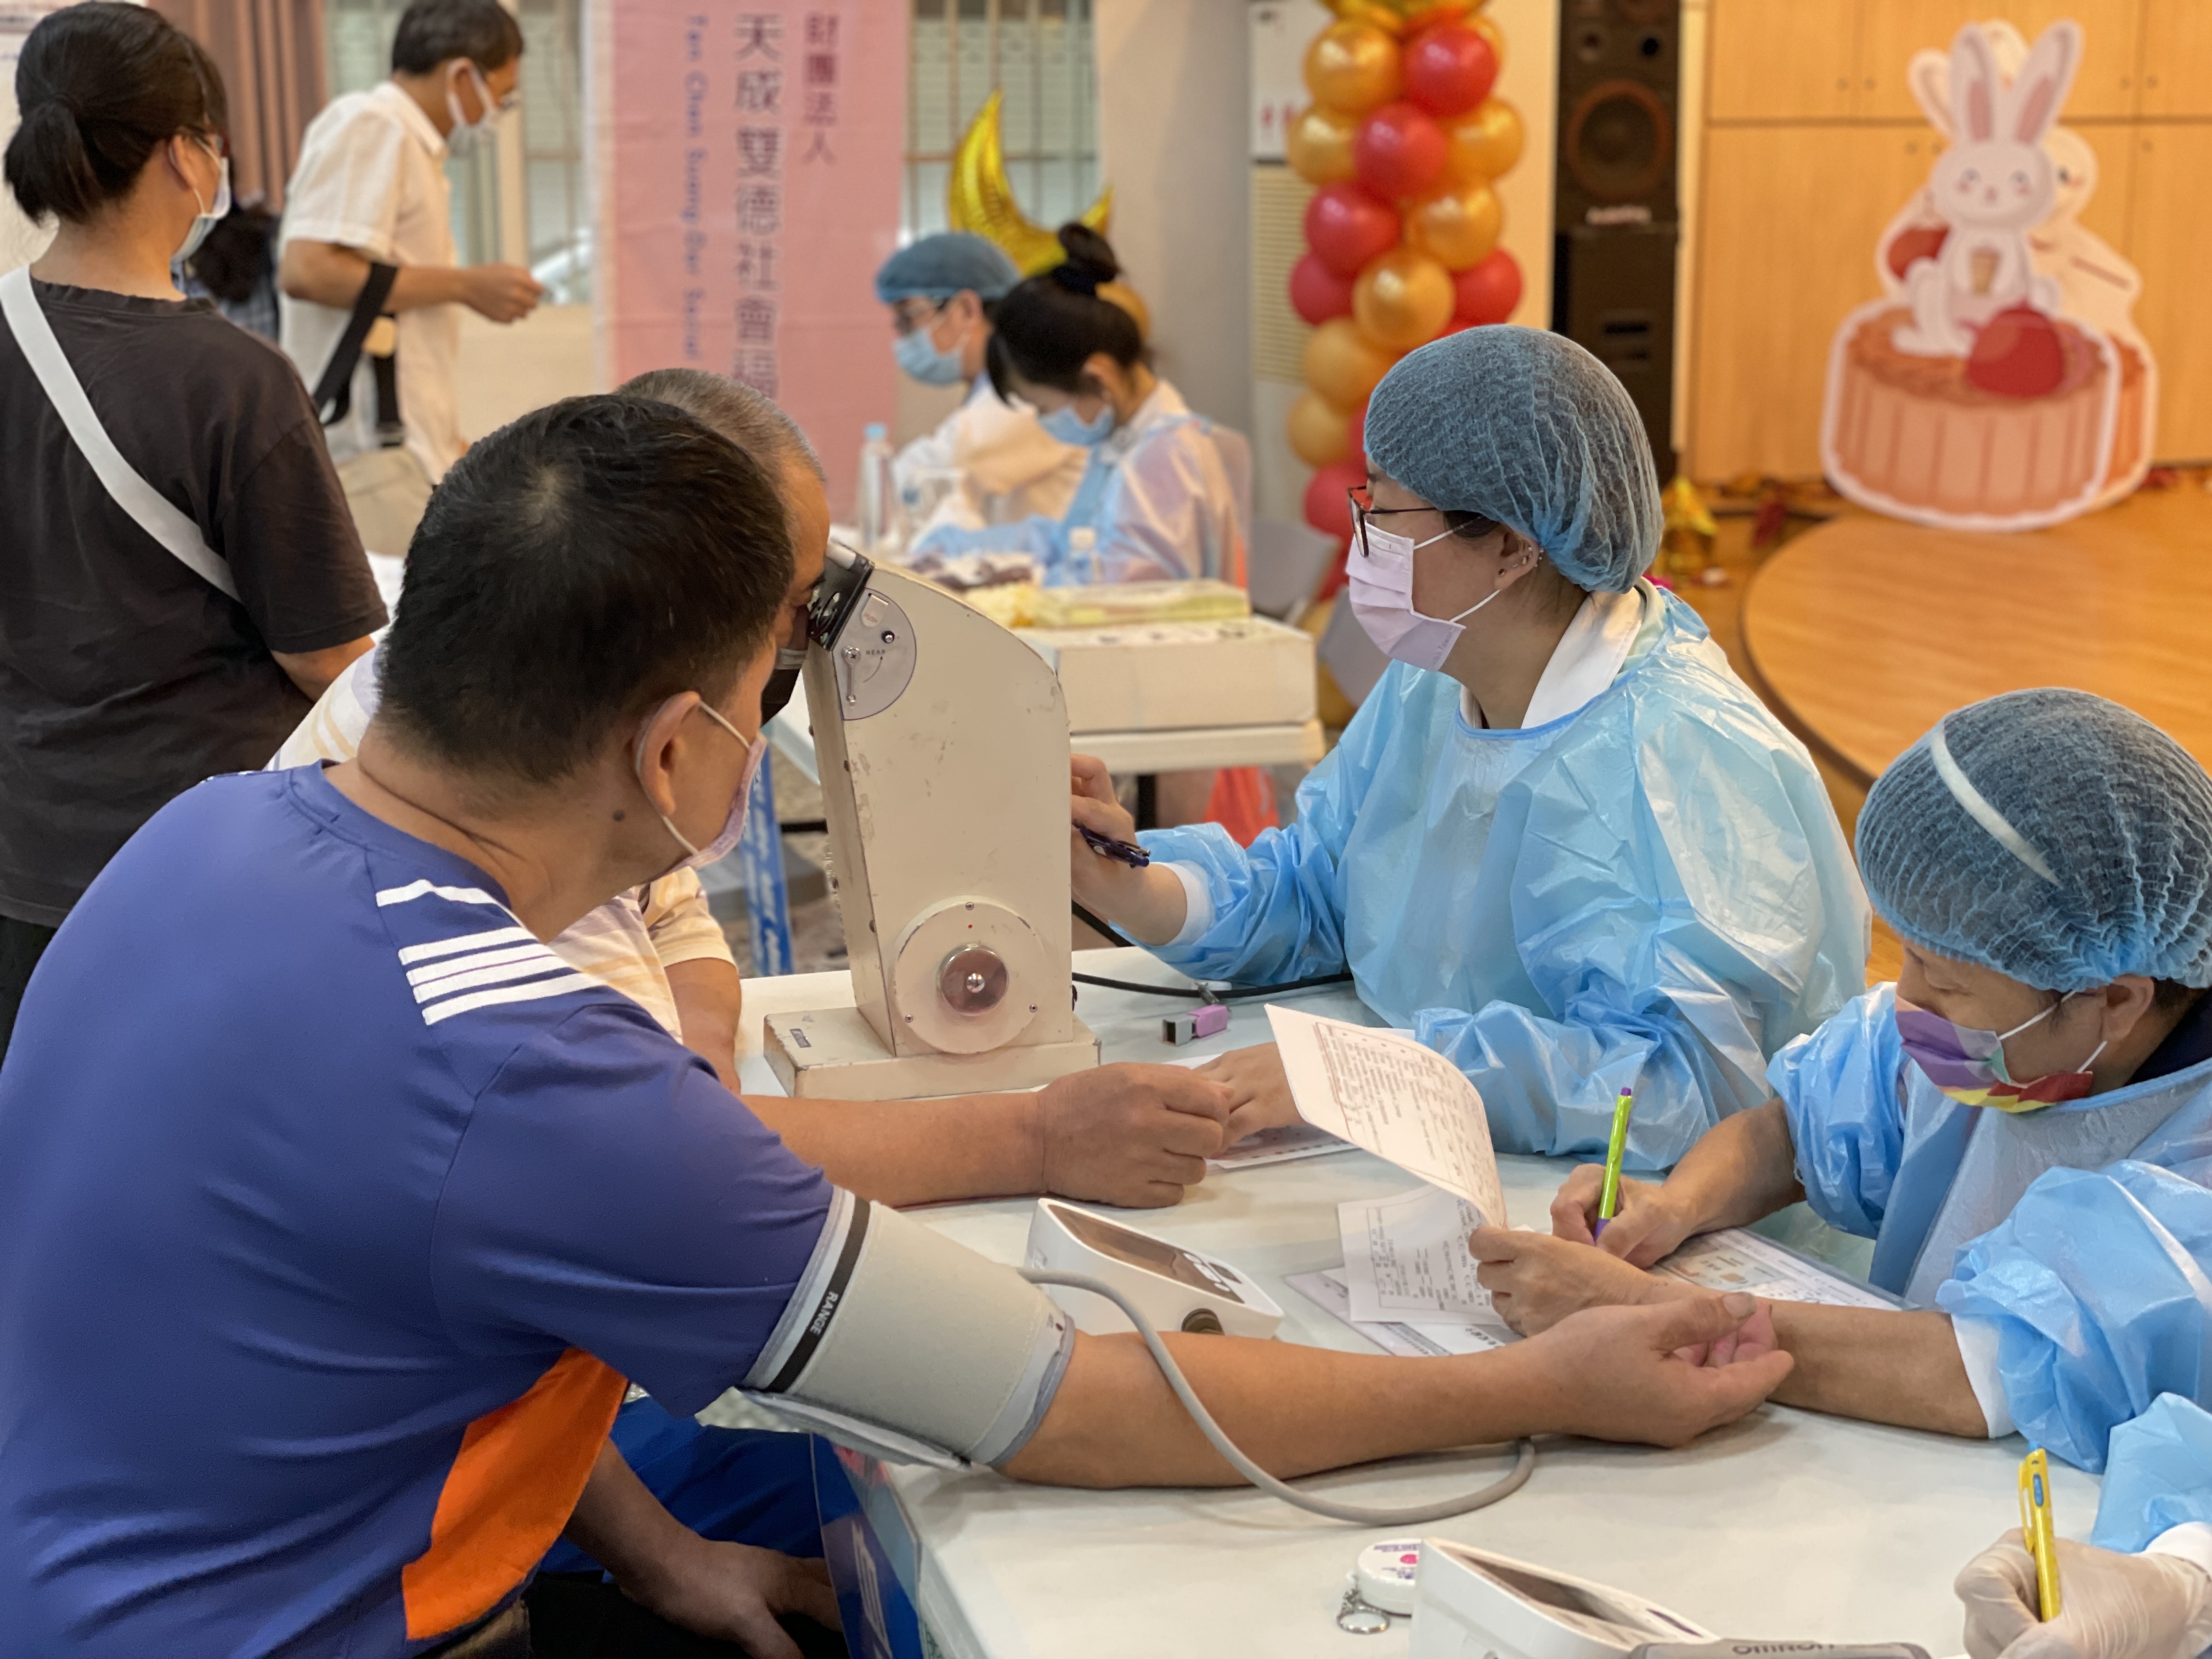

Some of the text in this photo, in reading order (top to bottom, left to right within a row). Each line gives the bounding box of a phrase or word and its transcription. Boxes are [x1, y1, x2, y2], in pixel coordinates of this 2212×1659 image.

[803, 12, 838, 165] 財團法人
[810, 1291, 838, 1335] RANGE
